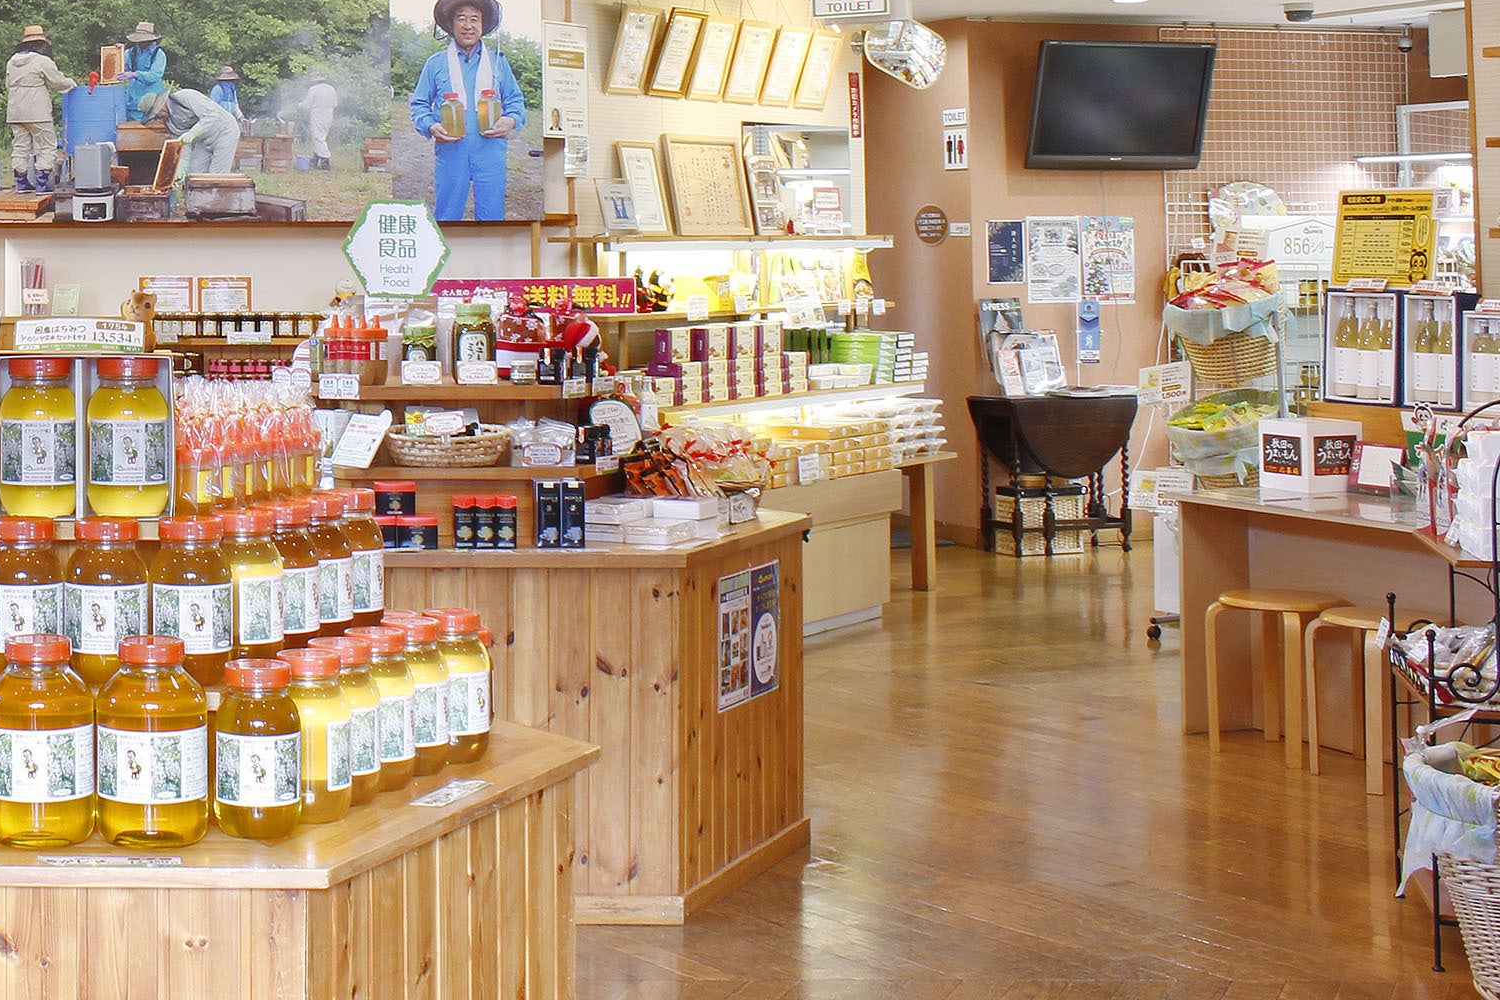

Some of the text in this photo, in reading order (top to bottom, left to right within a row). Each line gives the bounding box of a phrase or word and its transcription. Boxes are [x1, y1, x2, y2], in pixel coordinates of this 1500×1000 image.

[826, 0, 872, 12] TOILET
[943, 111, 966, 123] TOILET
[378, 214, 418, 235] 健康
[378, 238, 418, 259] 食品
[1283, 236, 1334, 255] 856シリー
[379, 264, 413, 275] Health
[383, 277, 410, 288] Food
[442, 288, 470, 297] 大人気の
[523, 284, 632, 309] 送料無料!!
[34, 324, 87, 335] 国産はちみつ
[1271, 437, 1294, 449] 秋田の
[1323, 439, 1350, 450] 秋田の
[1265, 445, 1299, 462] うまいもん
